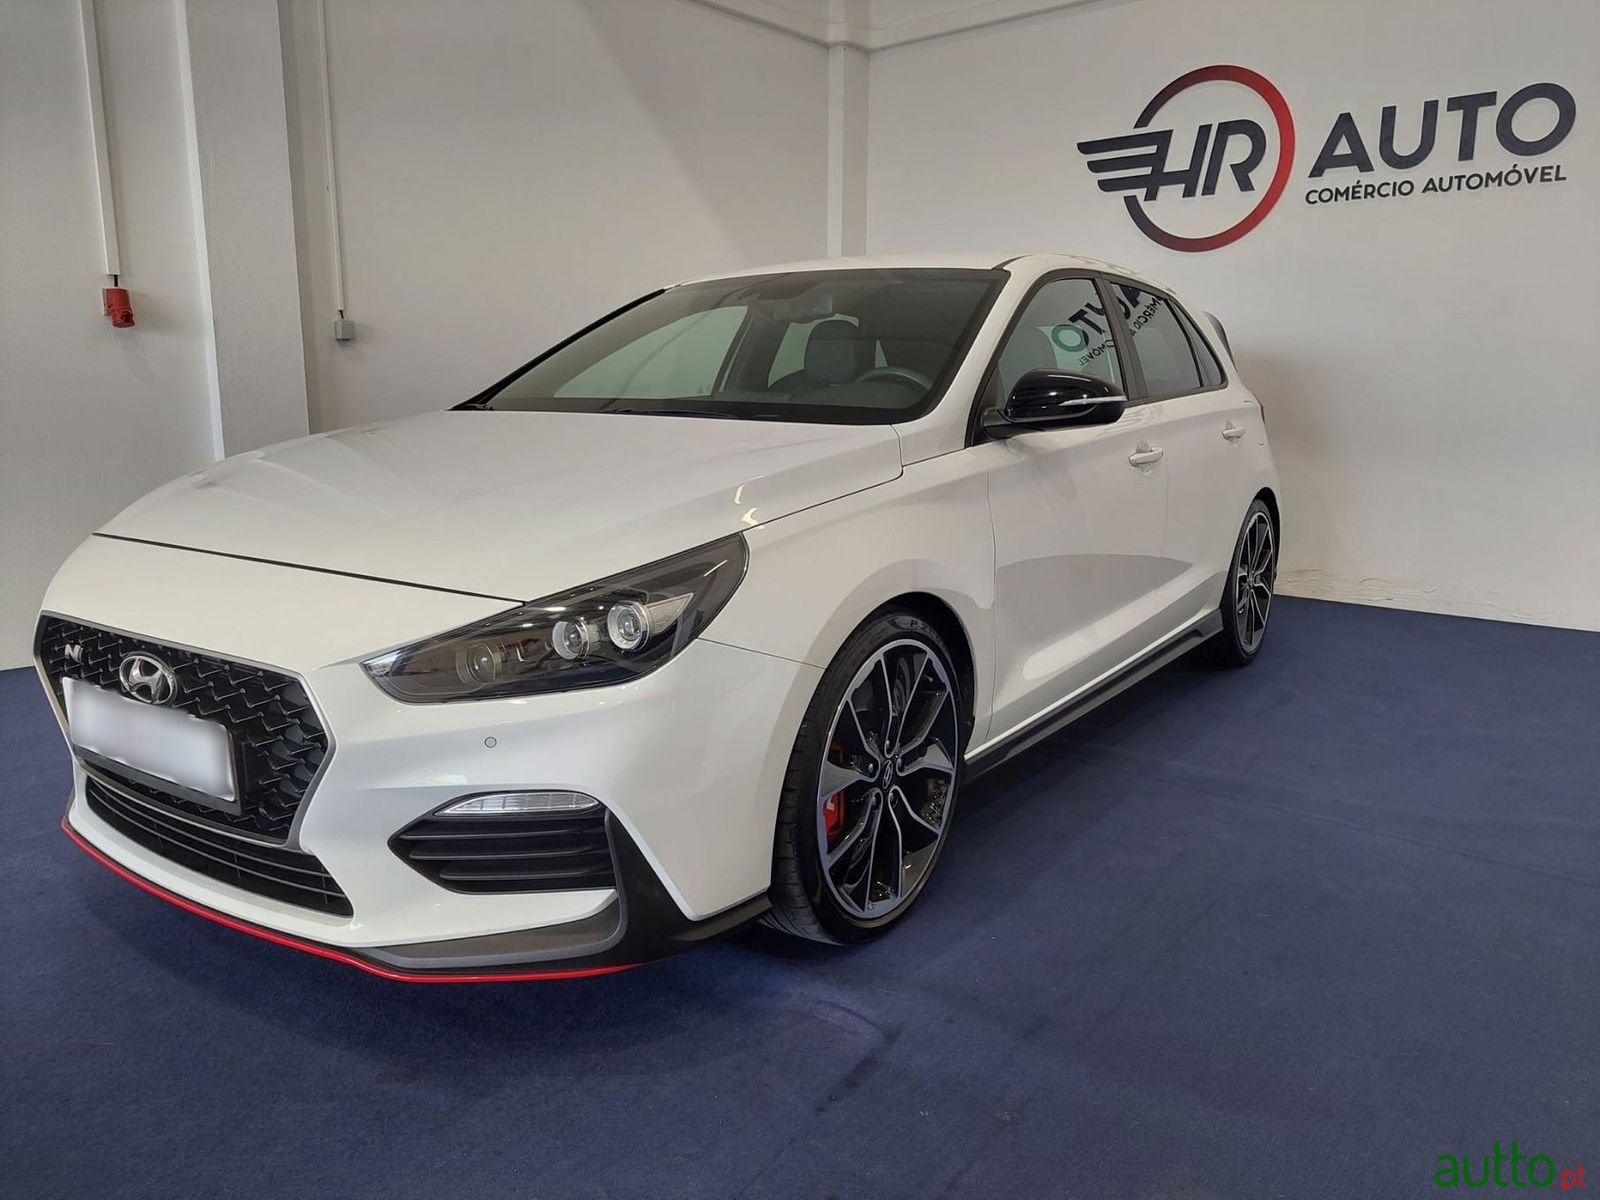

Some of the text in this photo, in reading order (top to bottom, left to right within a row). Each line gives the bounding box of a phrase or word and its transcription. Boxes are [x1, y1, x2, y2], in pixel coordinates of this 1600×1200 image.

[1307, 82, 1577, 178] AUTO
[1304, 163, 1567, 205] COMÉRCIO AUTOMÓVEL
